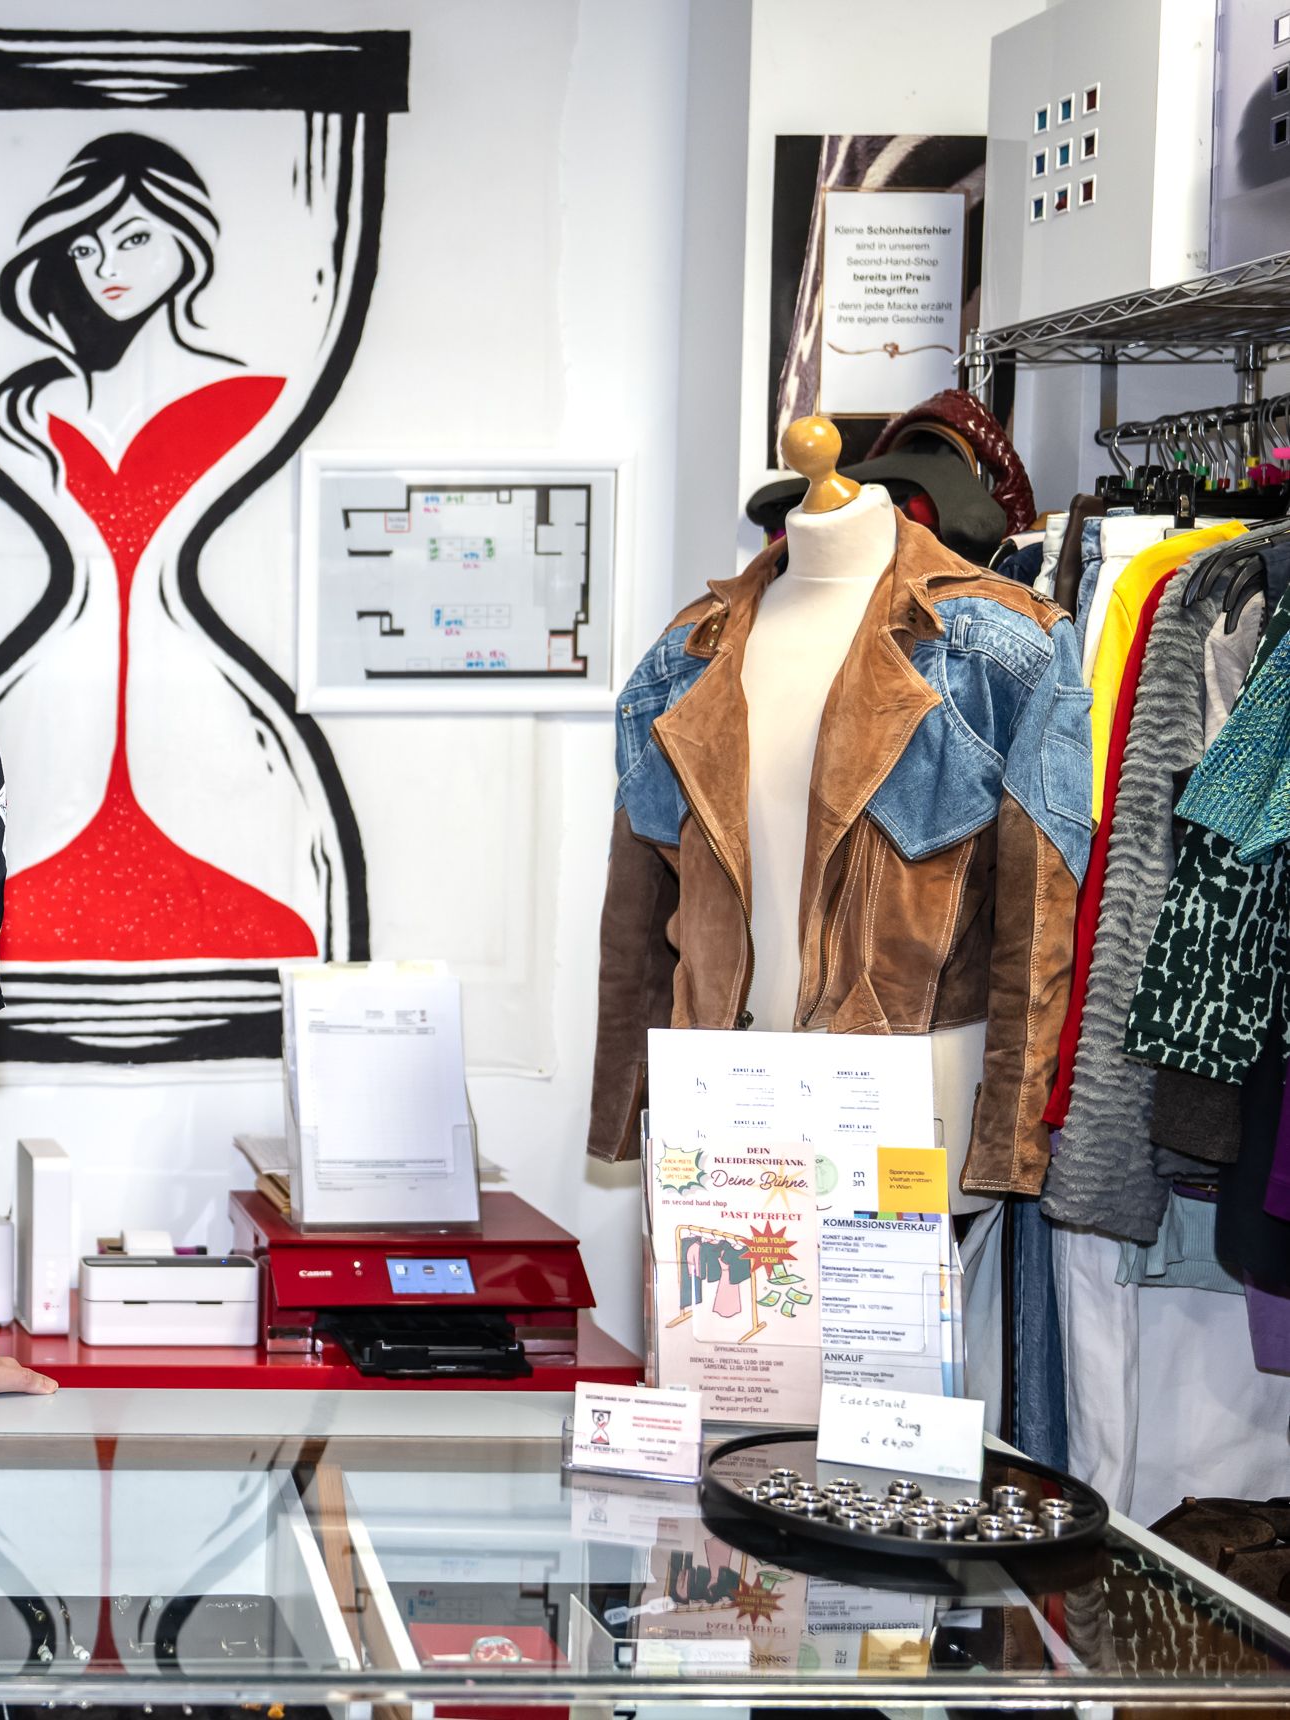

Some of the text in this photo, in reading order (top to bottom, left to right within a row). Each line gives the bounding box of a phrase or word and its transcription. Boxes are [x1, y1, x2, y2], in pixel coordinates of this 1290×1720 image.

[834, 225, 952, 236] Kleine Schönheitsfehler
[856, 241, 876, 250] sind
[877, 241, 886, 250] in
[846, 256, 939, 268] Second-Hand-Shop
[853, 273, 931, 282] bereits im Preis
[864, 285, 919, 296] inbegriffen
[838, 302, 953, 312] denn jede Macke erzählt
[857, 315, 889, 325] eigene
[892, 315, 944, 324] Geschichte
[747, 1147, 770, 1155] DEIN
[714, 1157, 807, 1167] KLEIDERSCHRANK.
[710, 1169, 755, 1187] Deine
[721, 1211, 803, 1221] PAST PERFECT
[823, 1218, 937, 1232] KOMMISSIONSVERKAUF
[752, 1236, 768, 1244] TURN
[750, 1246, 773, 1254] CLOSET
[298, 1270, 332, 1278] Canon
[824, 1353, 864, 1363] ANKAUF
[840, 1394, 907, 1409] Edelstahl
[895, 1417, 921, 1435] Ring
